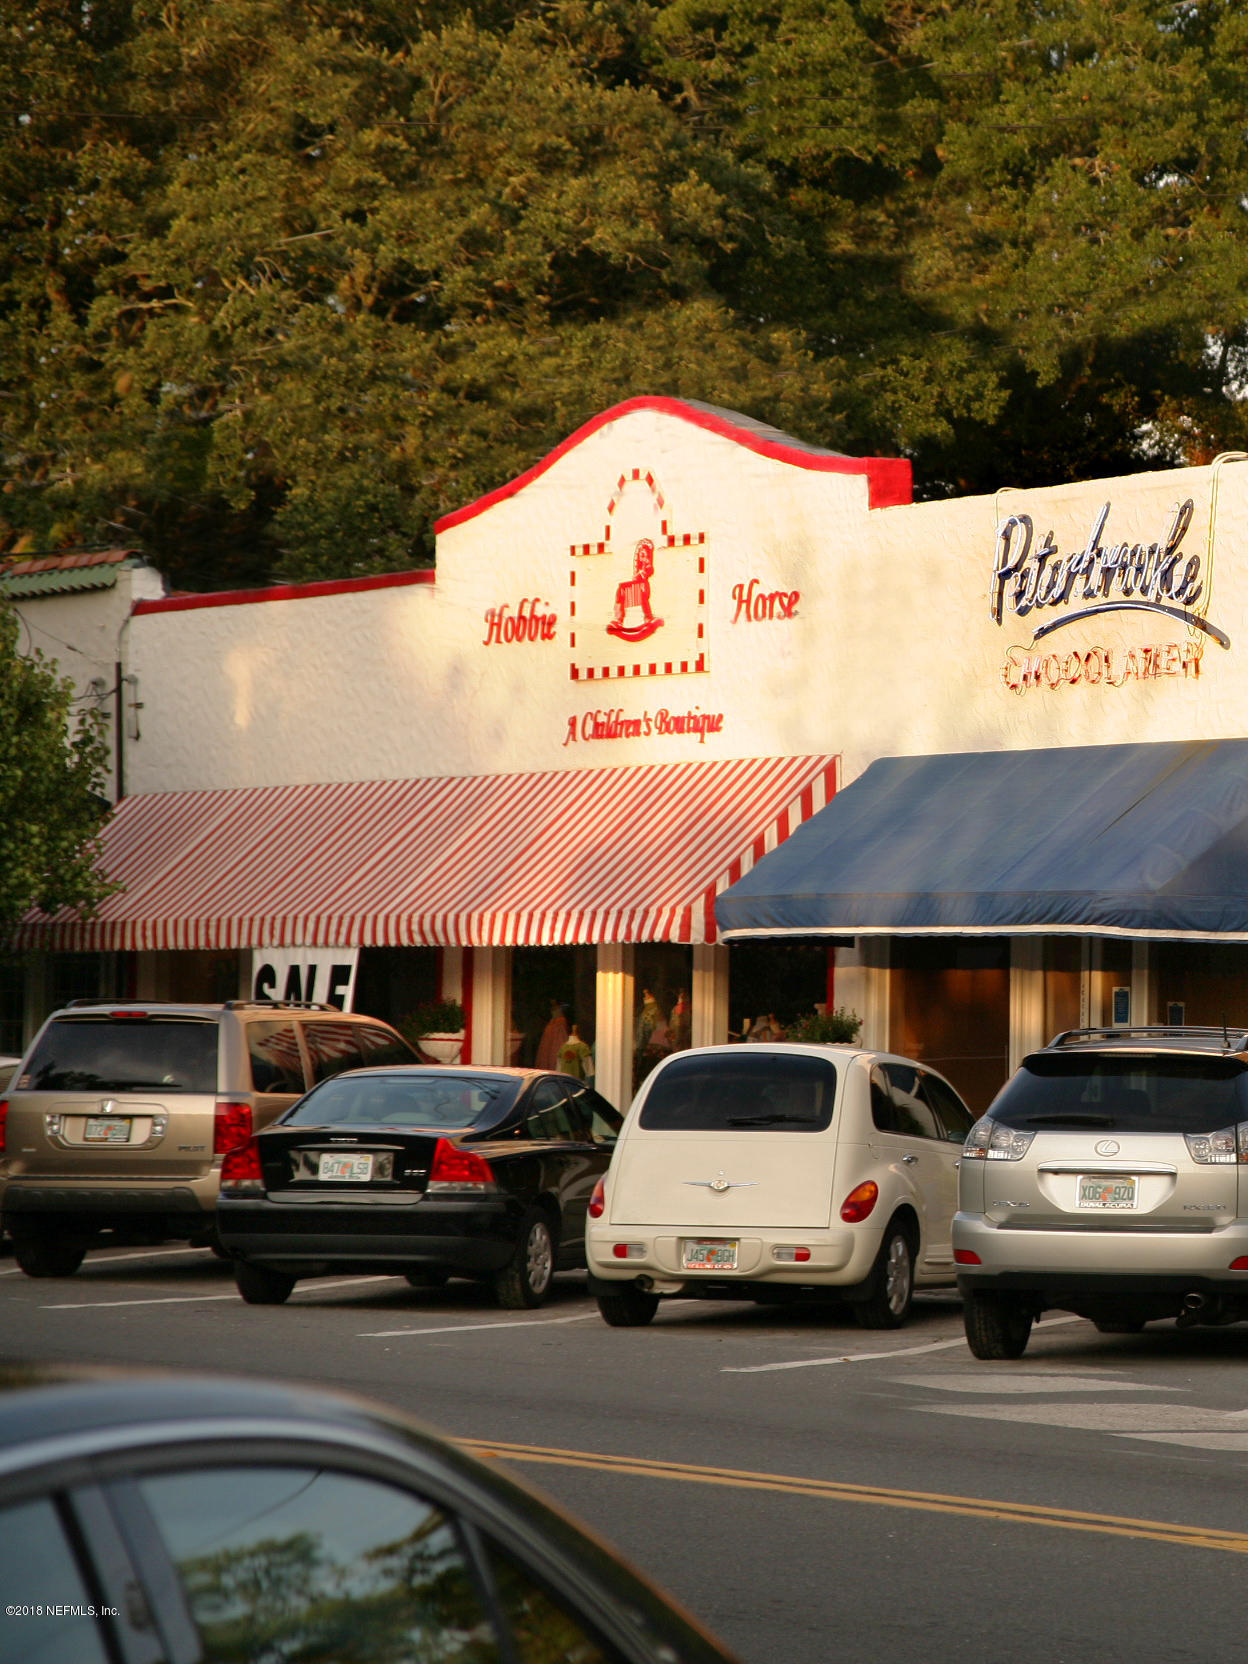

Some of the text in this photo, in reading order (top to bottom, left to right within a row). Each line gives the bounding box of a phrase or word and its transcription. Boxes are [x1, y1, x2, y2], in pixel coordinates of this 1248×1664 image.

[483, 578, 800, 646] Hobbie Horse
[562, 706, 724, 747] A Children's Boutique
